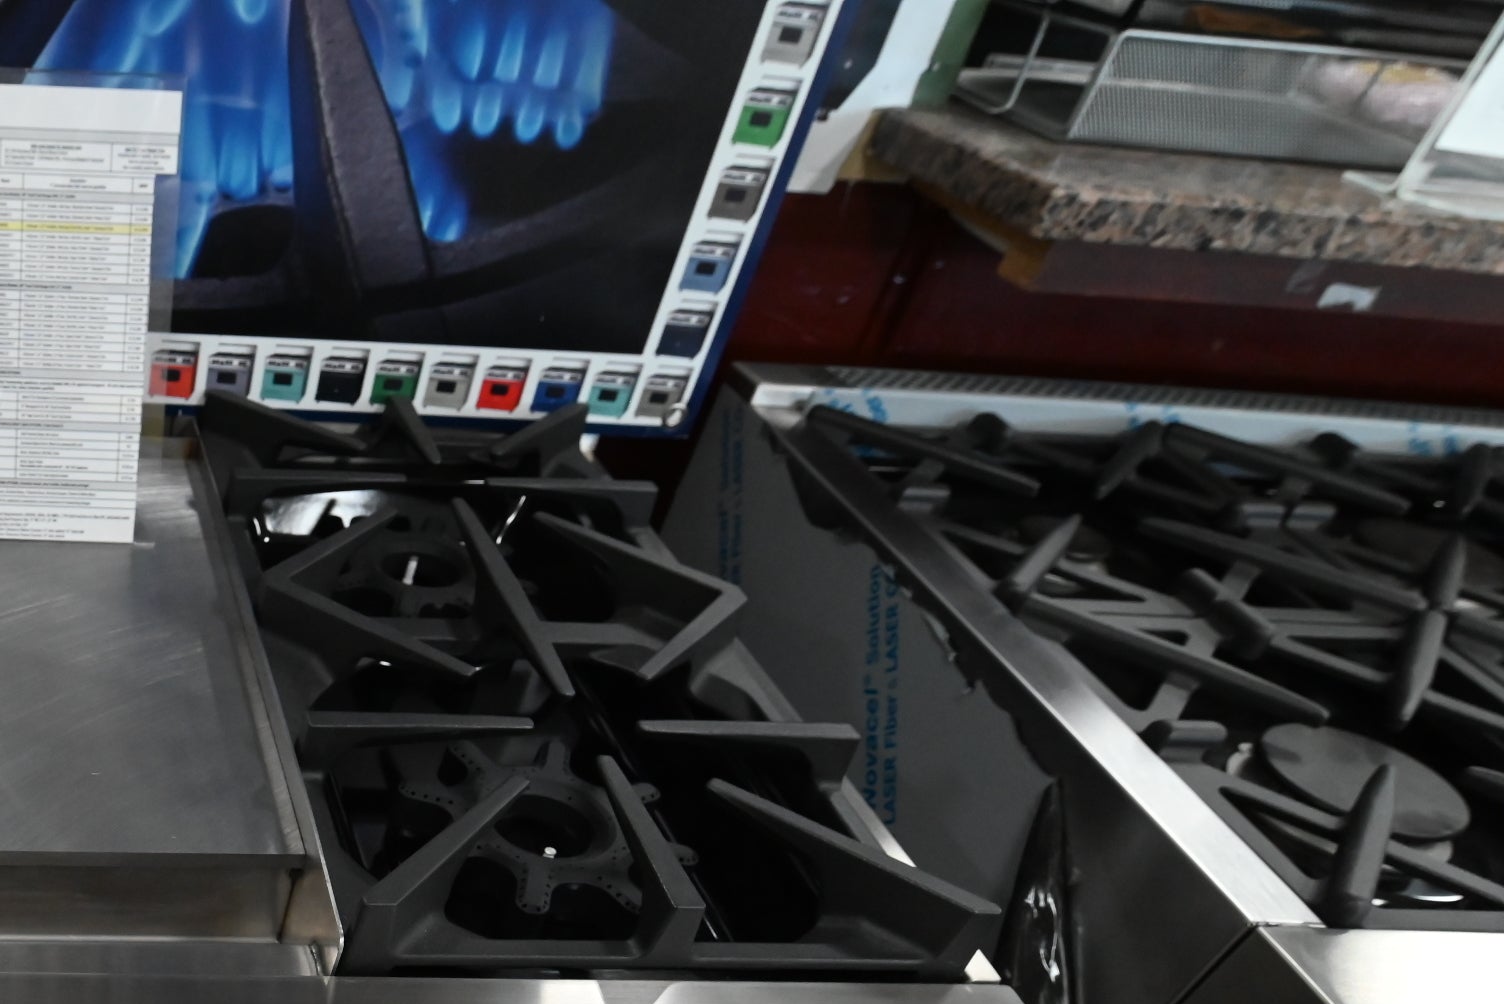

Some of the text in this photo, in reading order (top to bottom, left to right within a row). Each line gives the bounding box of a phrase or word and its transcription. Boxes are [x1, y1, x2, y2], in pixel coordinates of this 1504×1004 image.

[866, 565, 881, 667] Solution
[884, 604, 898, 672] LASER
[883, 695, 898, 750] Fiber
[883, 757, 898, 826] LASER
